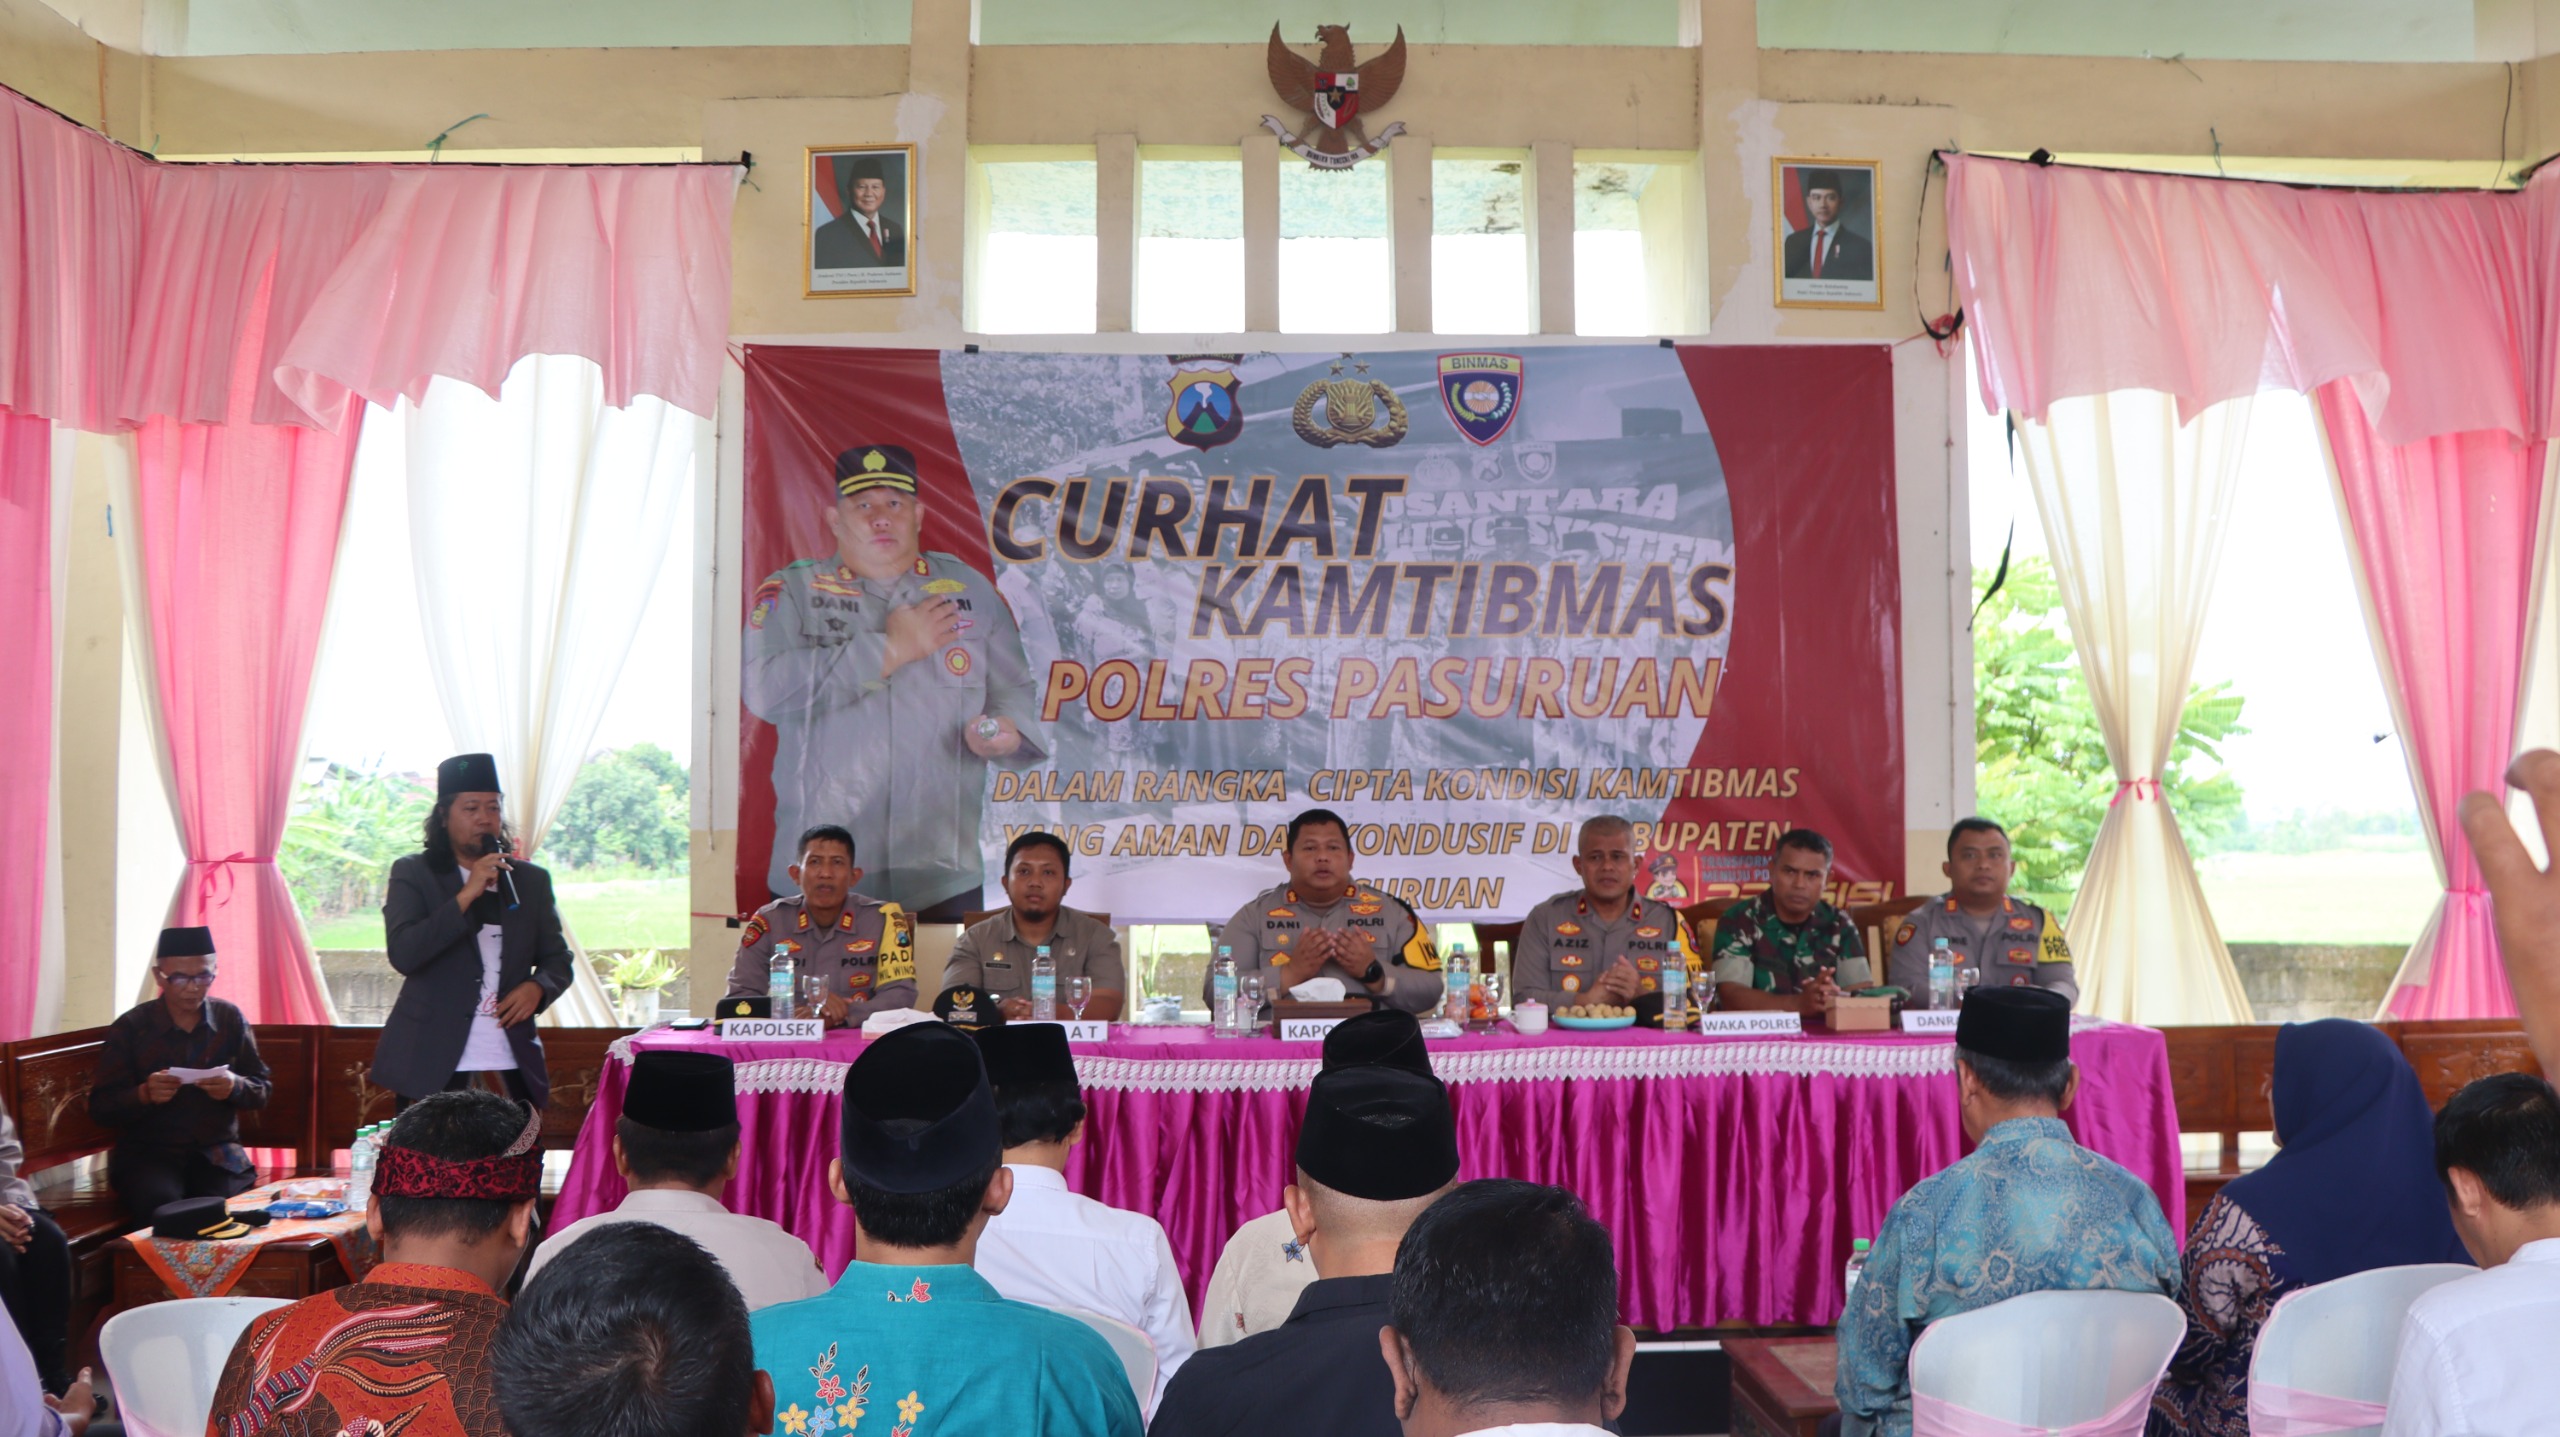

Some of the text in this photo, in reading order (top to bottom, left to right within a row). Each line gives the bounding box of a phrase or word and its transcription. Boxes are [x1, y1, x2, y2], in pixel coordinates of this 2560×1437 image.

[1452, 357, 1508, 370] BINMAS
[989, 474, 1409, 563] CURHAT
[811, 596, 859, 614] DANI
[1188, 562, 1736, 639] KAMTIBMAS
[1041, 656, 1724, 722] POLRES PASURUAN
[992, 766, 1801, 802] DALAM RANGKA CIPTA KONDISI KAMTIBMAS
[1003, 823, 1106, 857] YNG
[1110, 823, 1231, 857] AMAN
[1238, 822, 1288, 857] DA
[1532, 821, 1573, 853] DI
[1632, 820, 1794, 853] BUPATEN
[1266, 917, 1385, 930] DANI POLRI
[1553, 938, 1668, 951] AZIZ POLRI
[729, 1023, 816, 1037] KAPOLSEK
[1288, 1024, 1334, 1039] KAPO
[1704, 1018, 1800, 1032] WAKA POLRES
